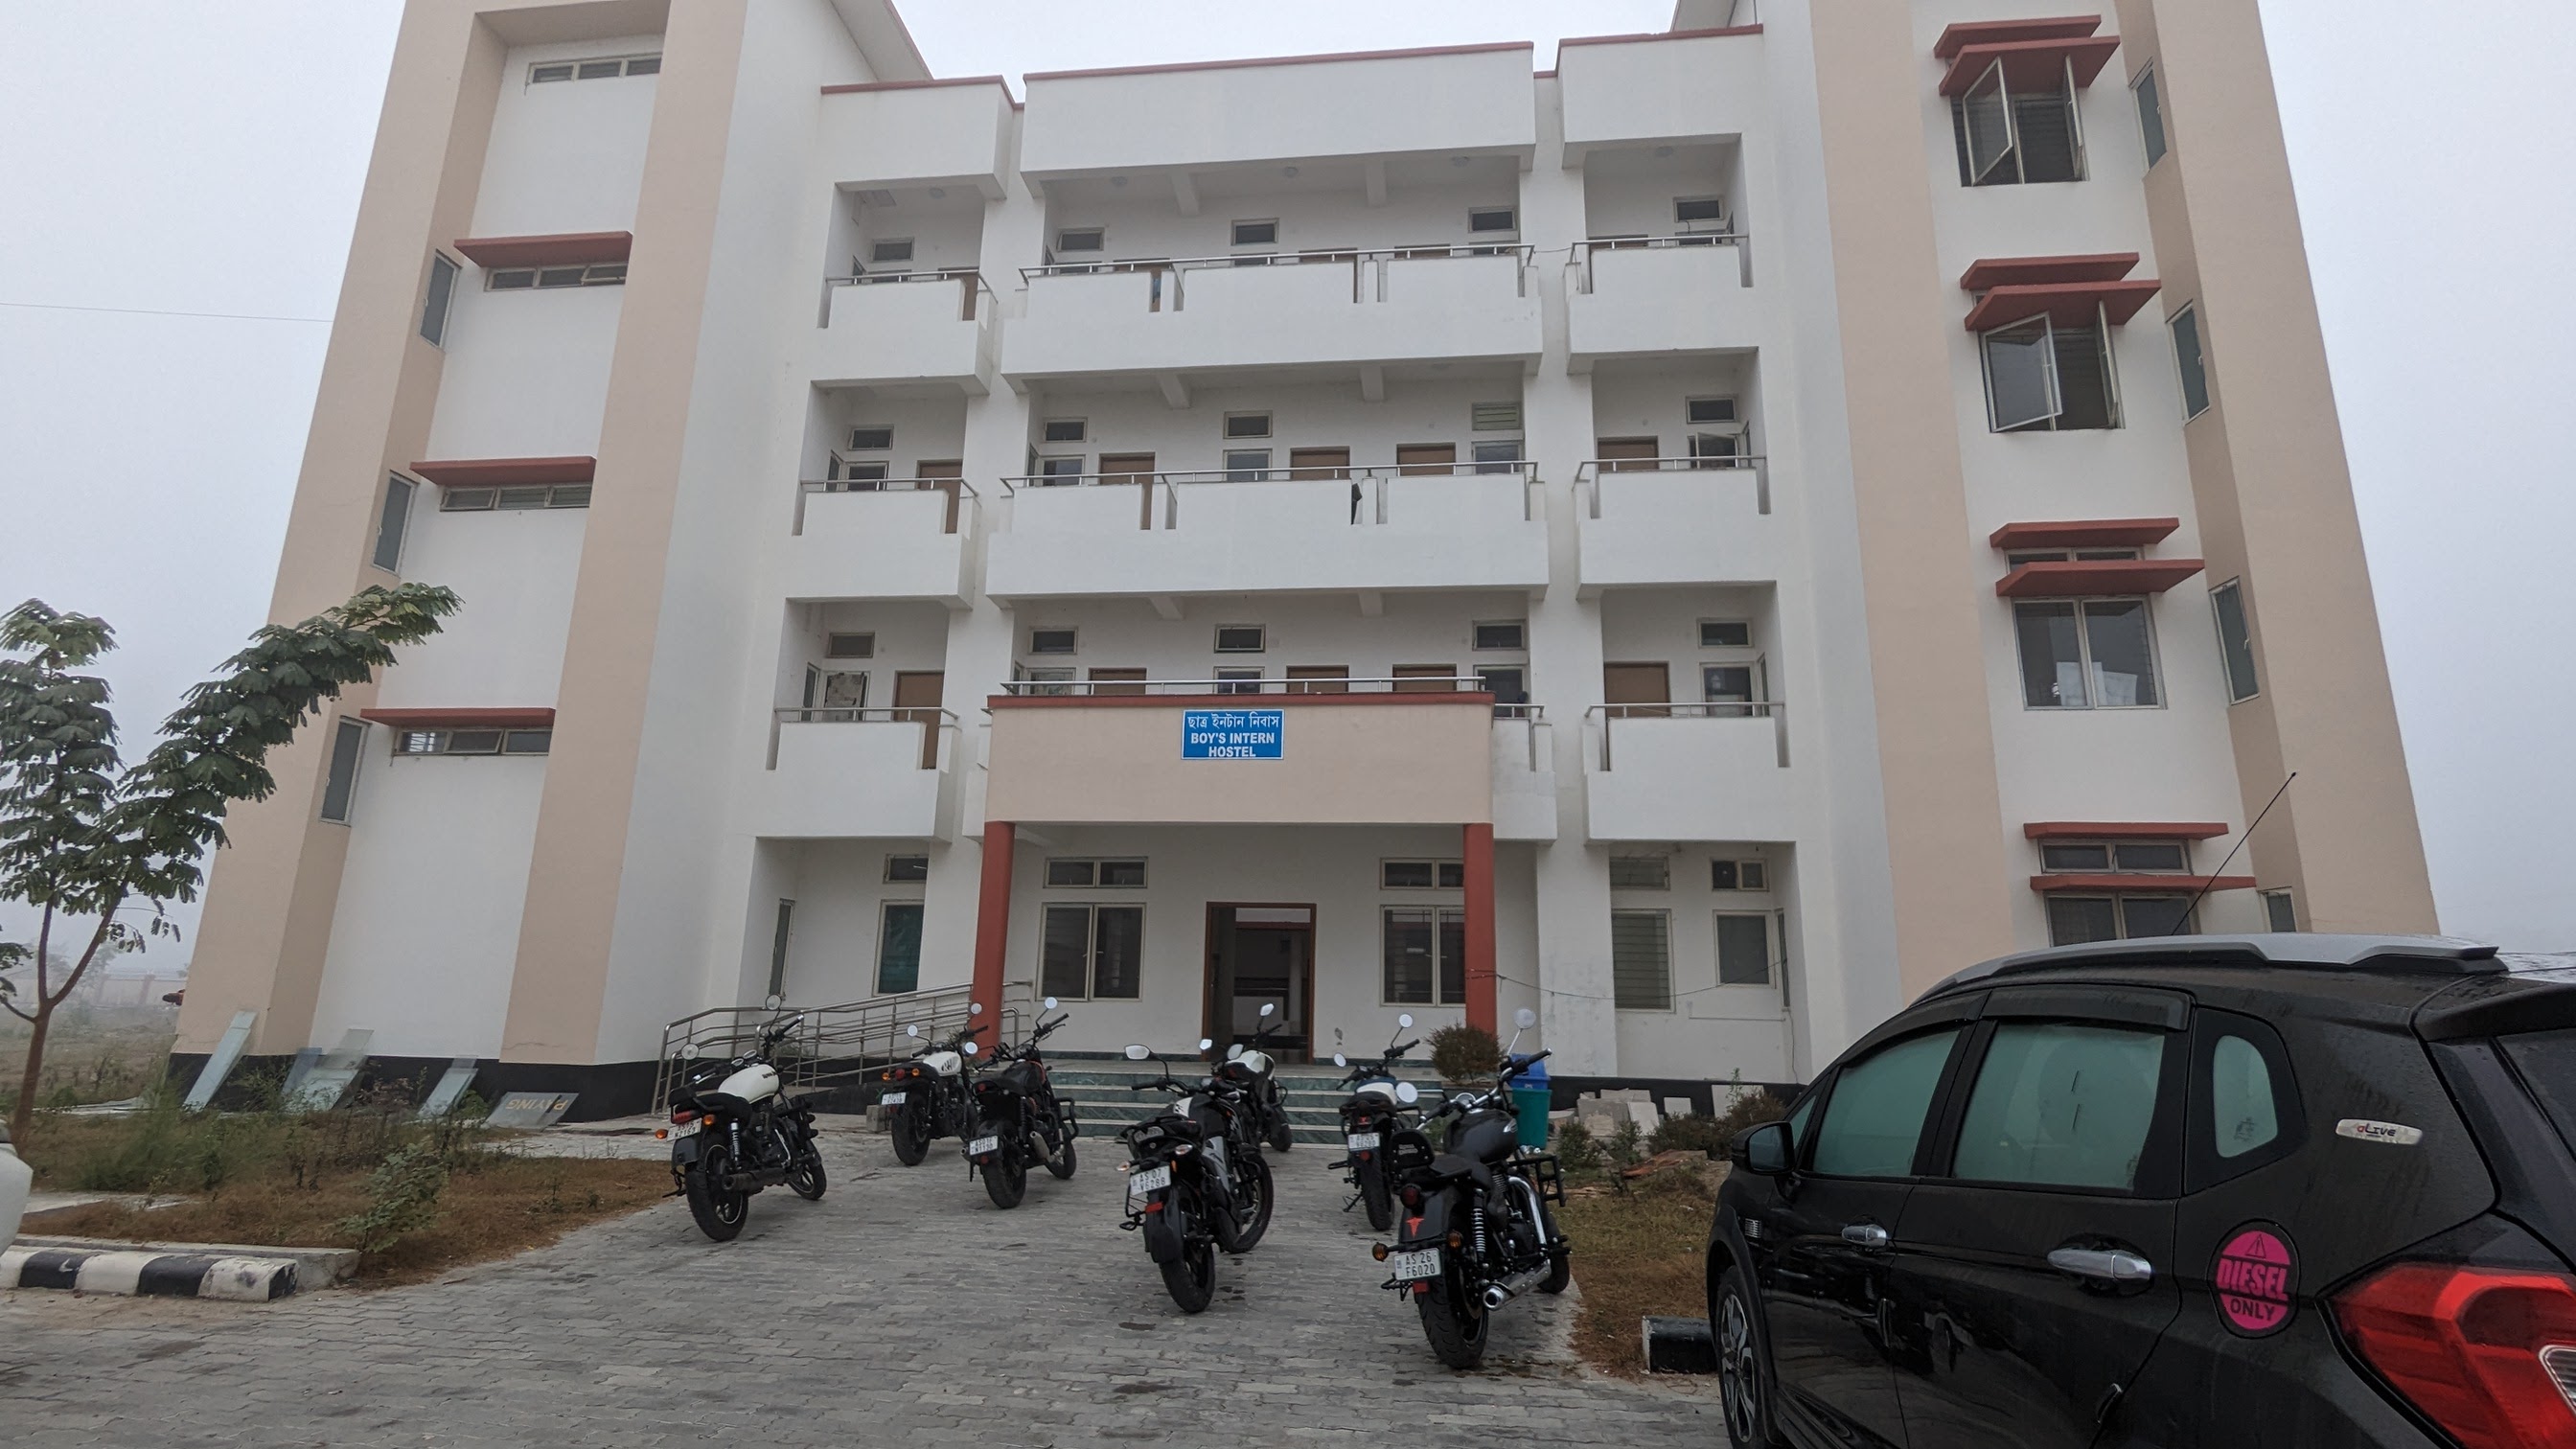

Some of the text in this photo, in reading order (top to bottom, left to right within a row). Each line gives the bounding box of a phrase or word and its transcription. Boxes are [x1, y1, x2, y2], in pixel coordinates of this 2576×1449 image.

[1249, 711, 1280, 728] নিবাস
[1190, 732, 1275, 744] BOY'S INTERN
[1208, 746, 1256, 757] HOSTEL
[1139, 1168, 1162, 1183] AS 07
[1406, 1252, 1432, 1265] AS 26
[1406, 1263, 1436, 1277] F6020
[2217, 1257, 2288, 1301] DIESEL
[2230, 1299, 2275, 1321] ONLY
